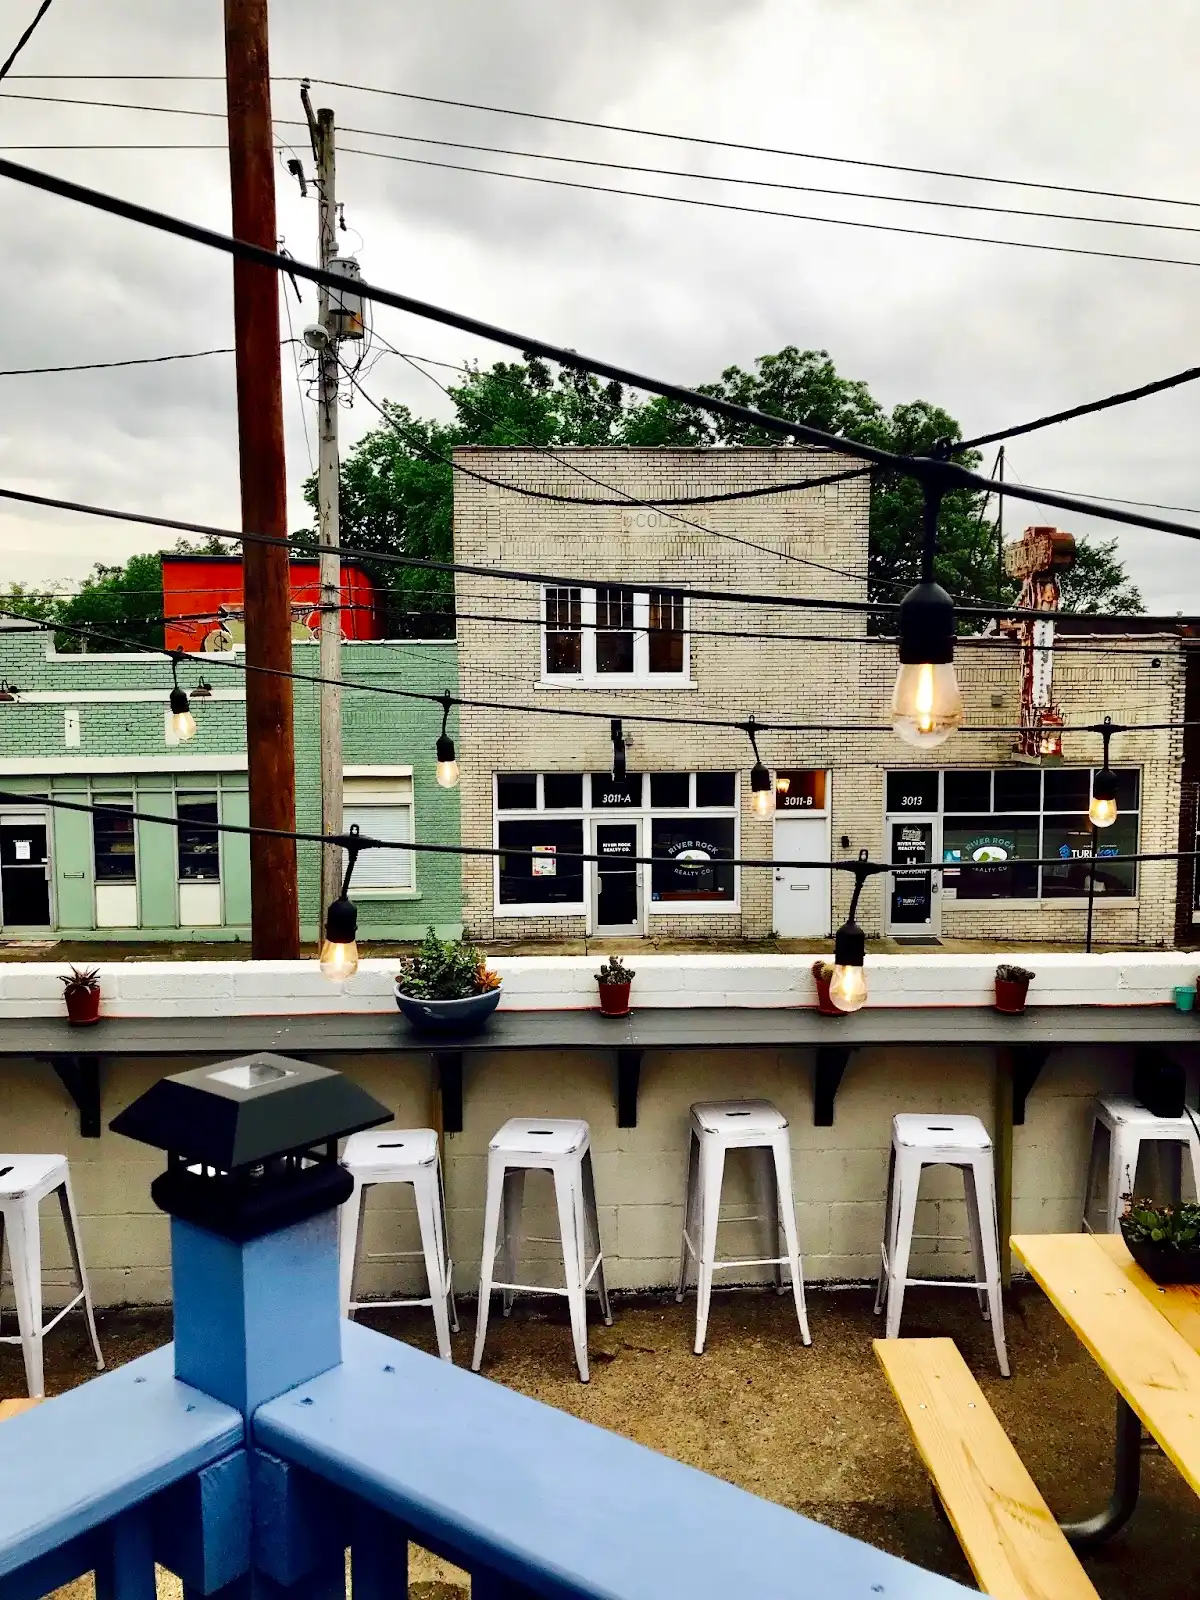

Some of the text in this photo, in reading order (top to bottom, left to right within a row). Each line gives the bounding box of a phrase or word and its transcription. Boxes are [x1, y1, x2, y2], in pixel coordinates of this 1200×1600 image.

[602, 793, 632, 804] 3011-A
[783, 796, 813, 806] 3011-B
[901, 795, 923, 806] 3013
[667, 840, 719, 855] RIVER ROCK
[965, 837, 1016, 852] RIVER ROCK
[674, 868, 699, 876] REALTY
